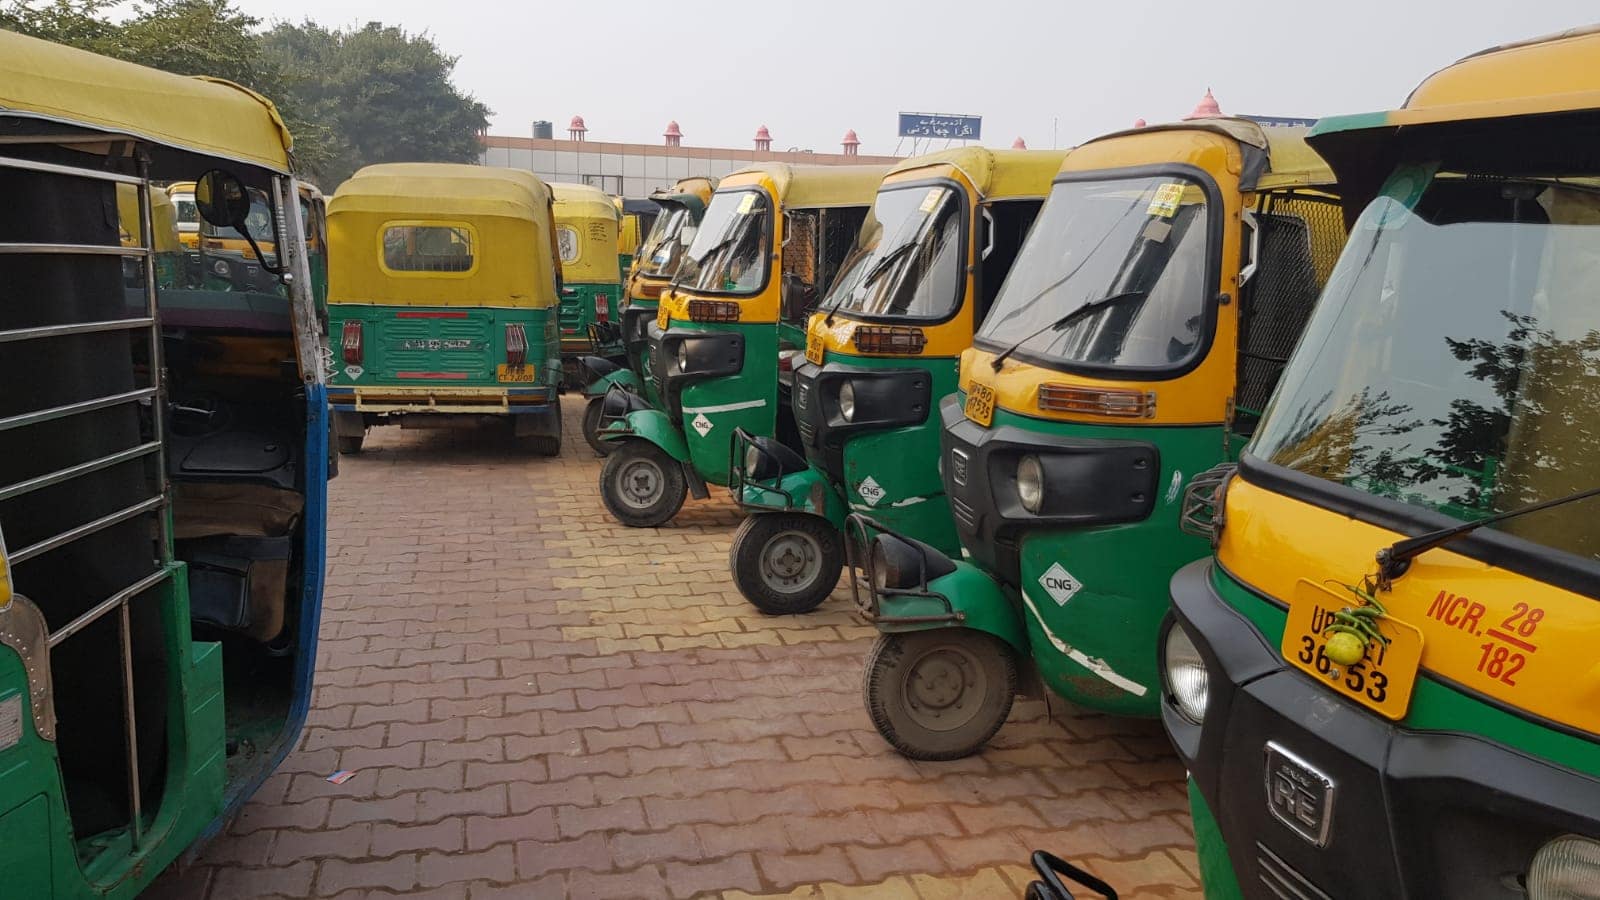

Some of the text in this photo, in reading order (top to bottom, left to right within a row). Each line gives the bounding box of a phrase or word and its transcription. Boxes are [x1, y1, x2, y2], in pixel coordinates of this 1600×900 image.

[695, 421, 709, 429] CNG
[862, 486, 880, 497] CNG
[1046, 577, 1072, 590] CNG
[1426, 590, 1545, 637] NCR. 28
[1477, 642, 1526, 687] 182
[1274, 770, 1317, 828] RE
